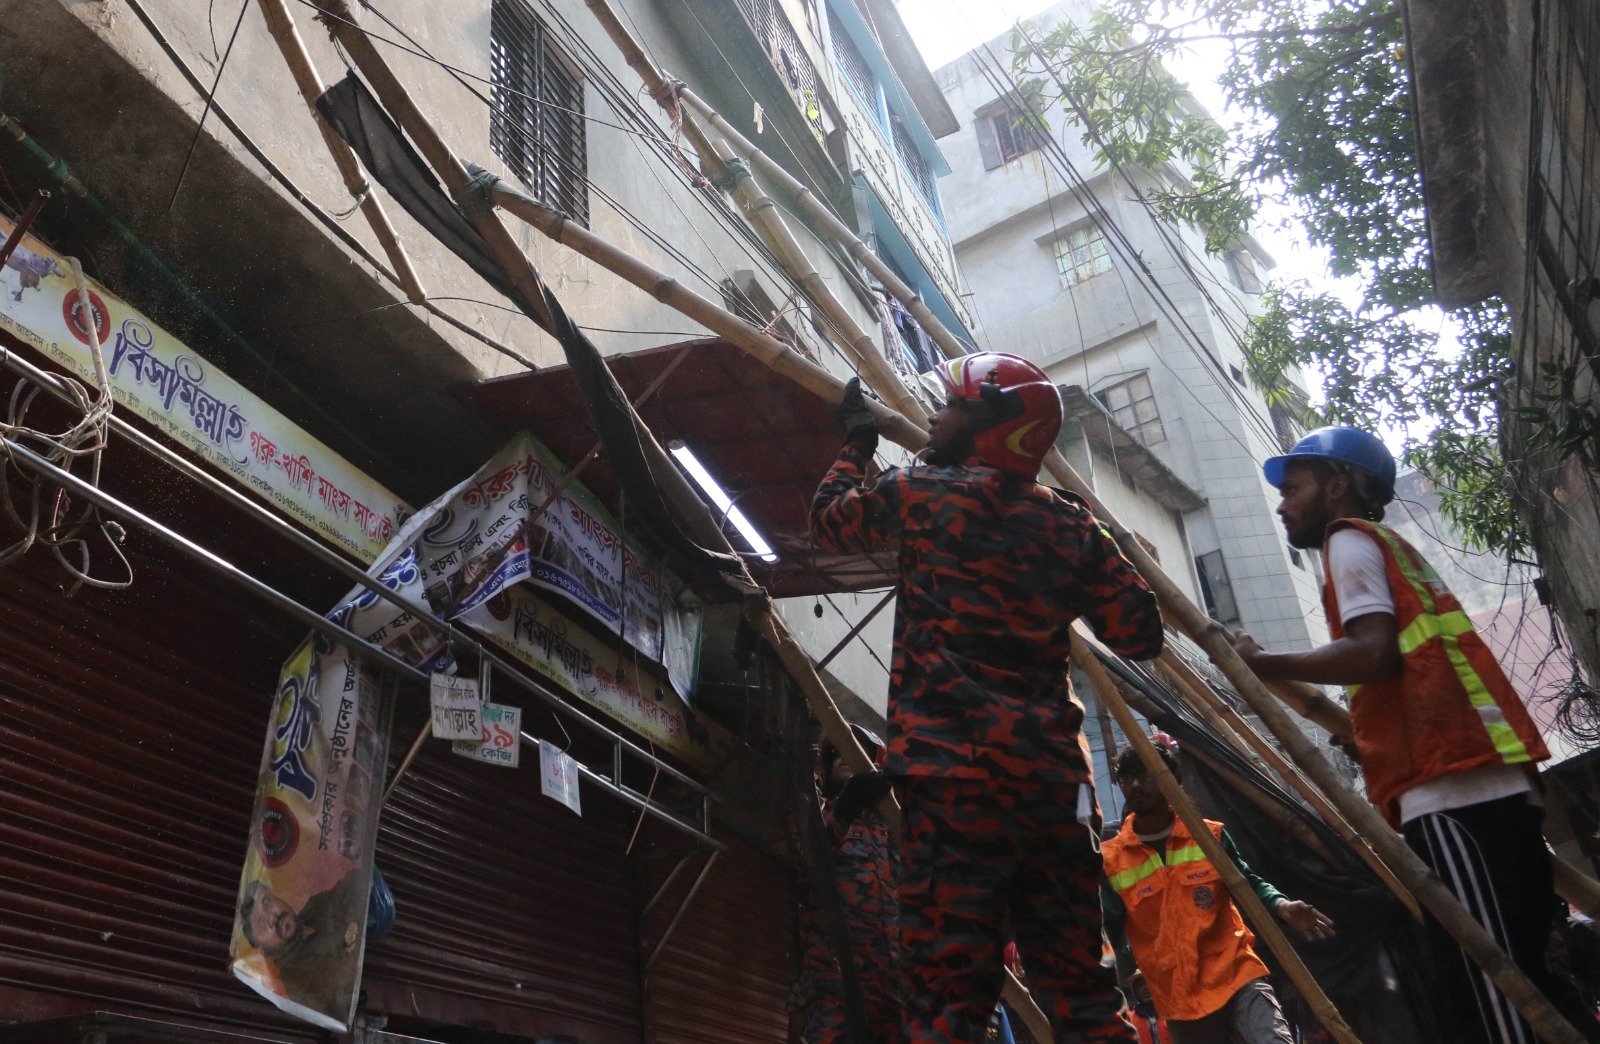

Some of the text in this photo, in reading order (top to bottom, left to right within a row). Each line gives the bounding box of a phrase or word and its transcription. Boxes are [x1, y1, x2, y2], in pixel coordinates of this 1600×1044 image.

[318, 475, 350, 519] মাংস
[485, 514, 511, 536] এবং
[481, 748, 512, 762] কেজি
